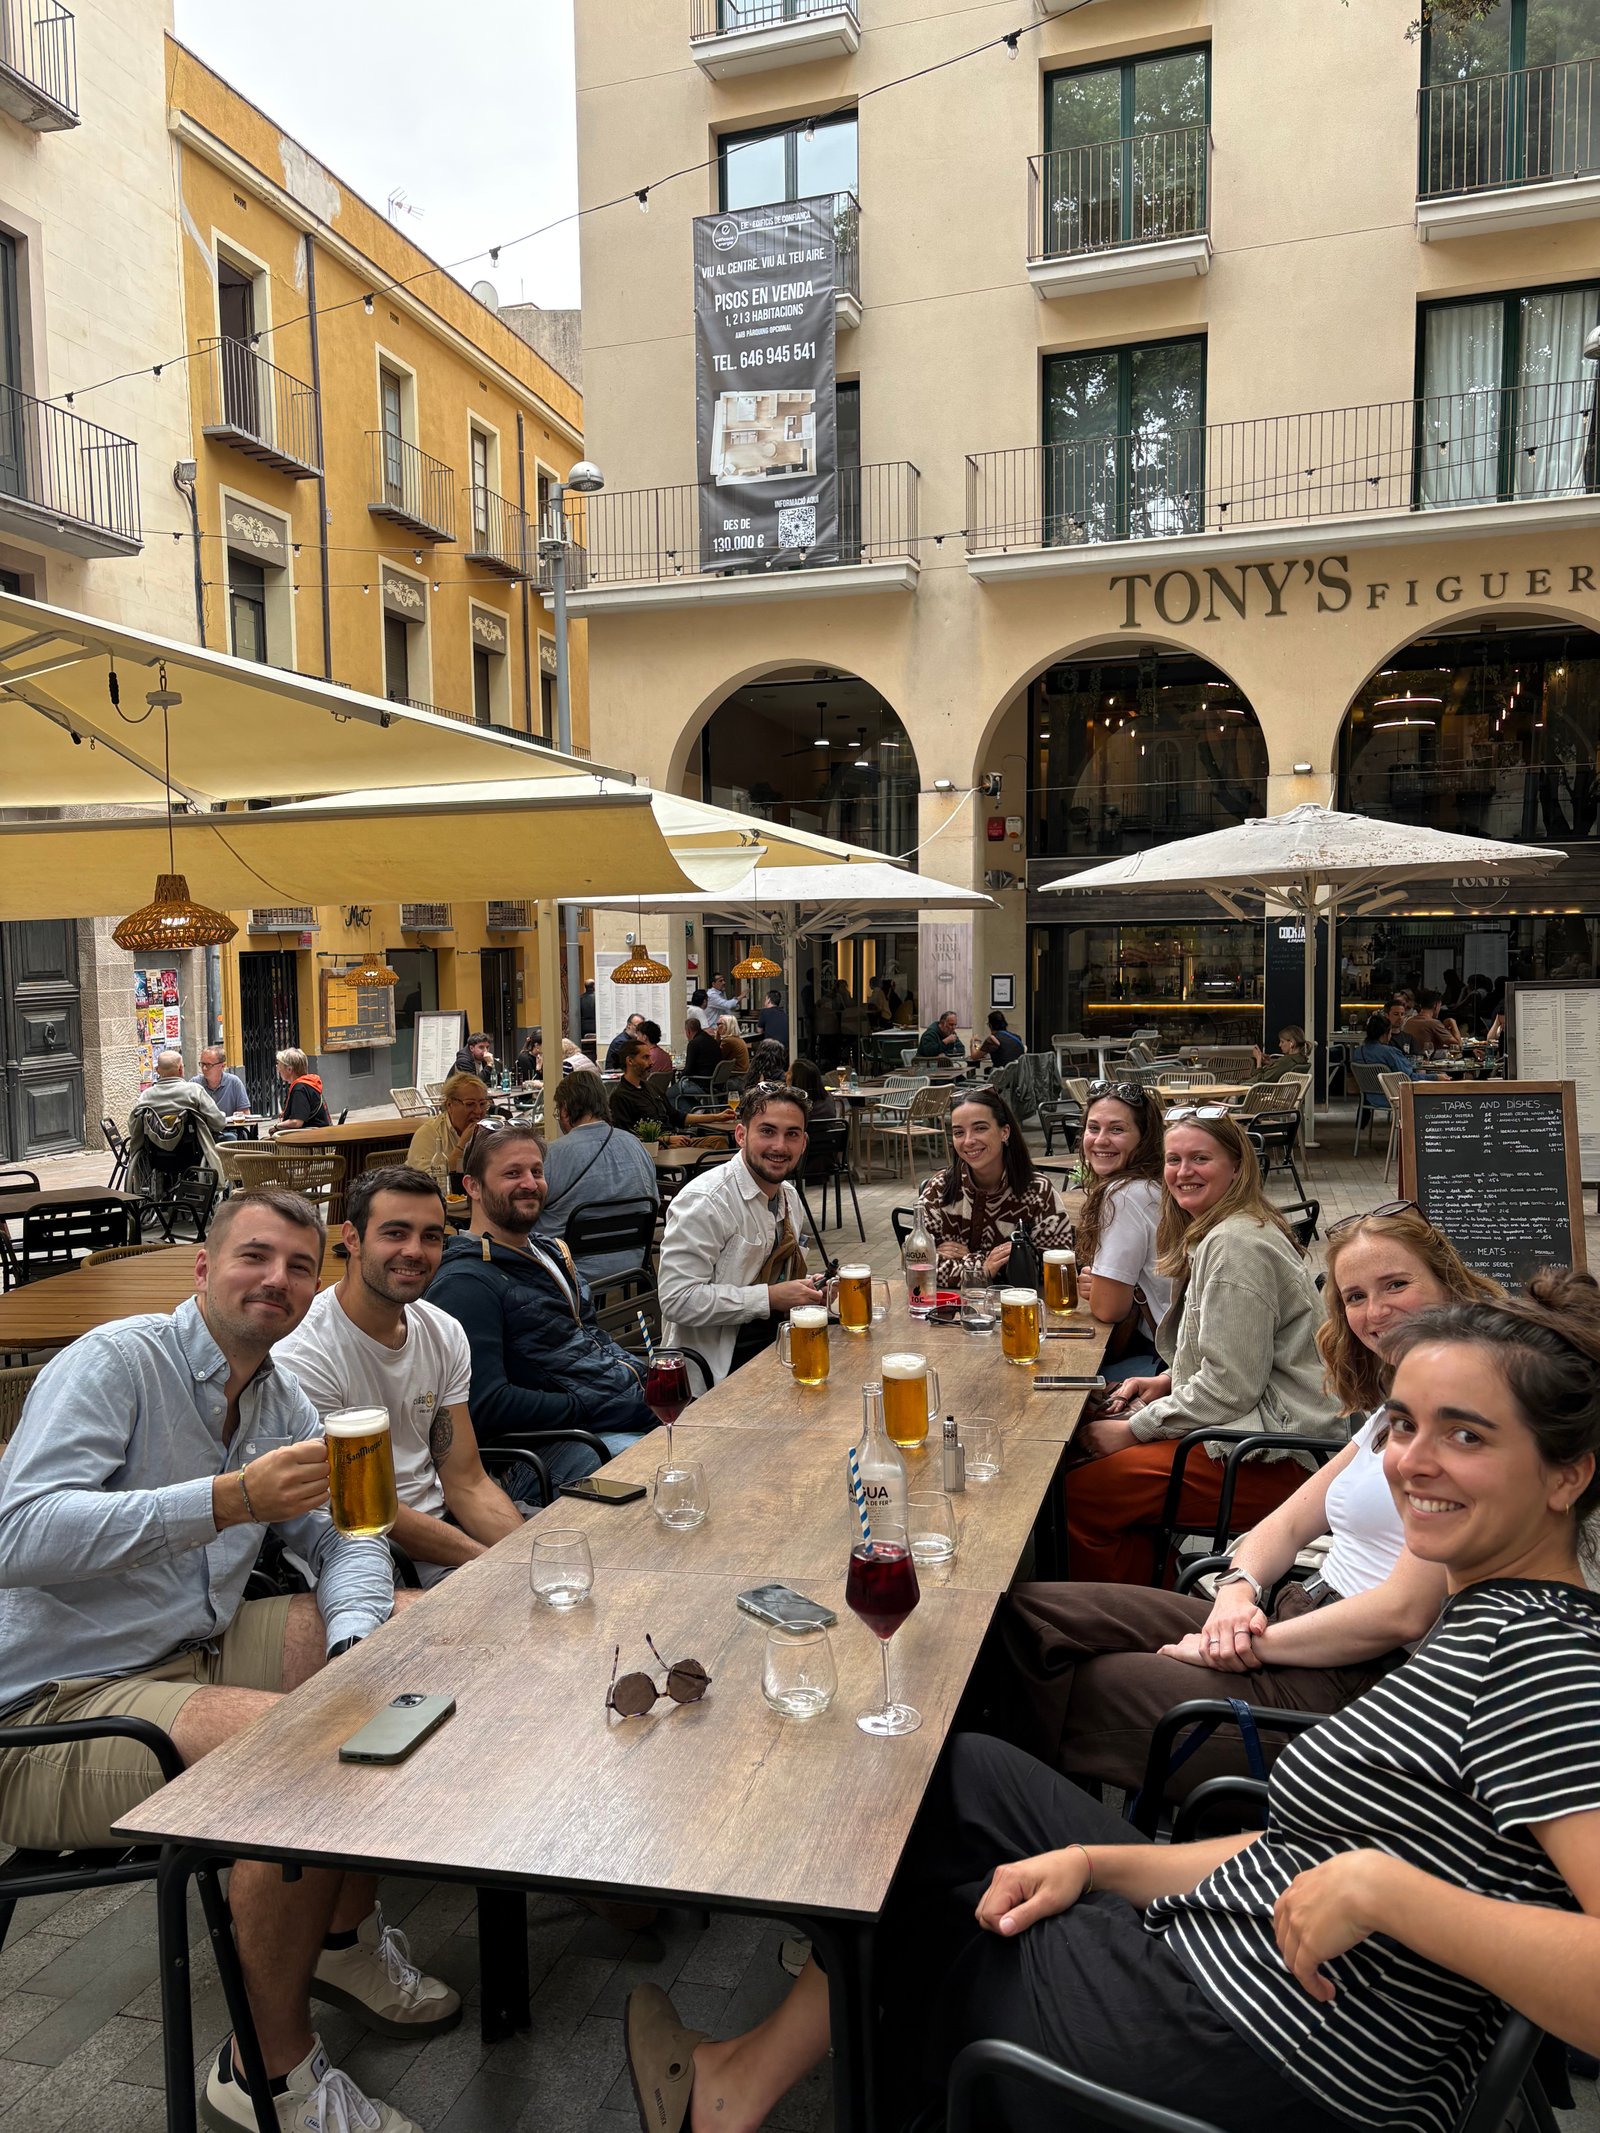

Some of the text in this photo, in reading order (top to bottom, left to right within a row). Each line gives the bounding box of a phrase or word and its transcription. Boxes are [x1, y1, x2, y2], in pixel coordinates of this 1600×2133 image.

[774, 216, 781, 224] DE
[702, 247, 827, 279] VIU AL CENTRE. VIU AL TEU AIRE.
[715, 280, 814, 312] PISOS EN VENDA
[733, 313, 739, 325] 2
[744, 312, 750, 324] 3
[752, 303, 804, 323] HABITACIONS
[769, 324, 792, 334] OPCIONAL
[713, 341, 816, 372] TEL. 646 945 541
[723, 518, 751, 531] DES DE
[713, 534, 765, 553] 130.000 €
[1109, 556, 1352, 629] TONY'S
[1441, 1100, 1541, 1111] TAPAS AND DISHES
[1477, 1247, 1507, 1256] MEATS
